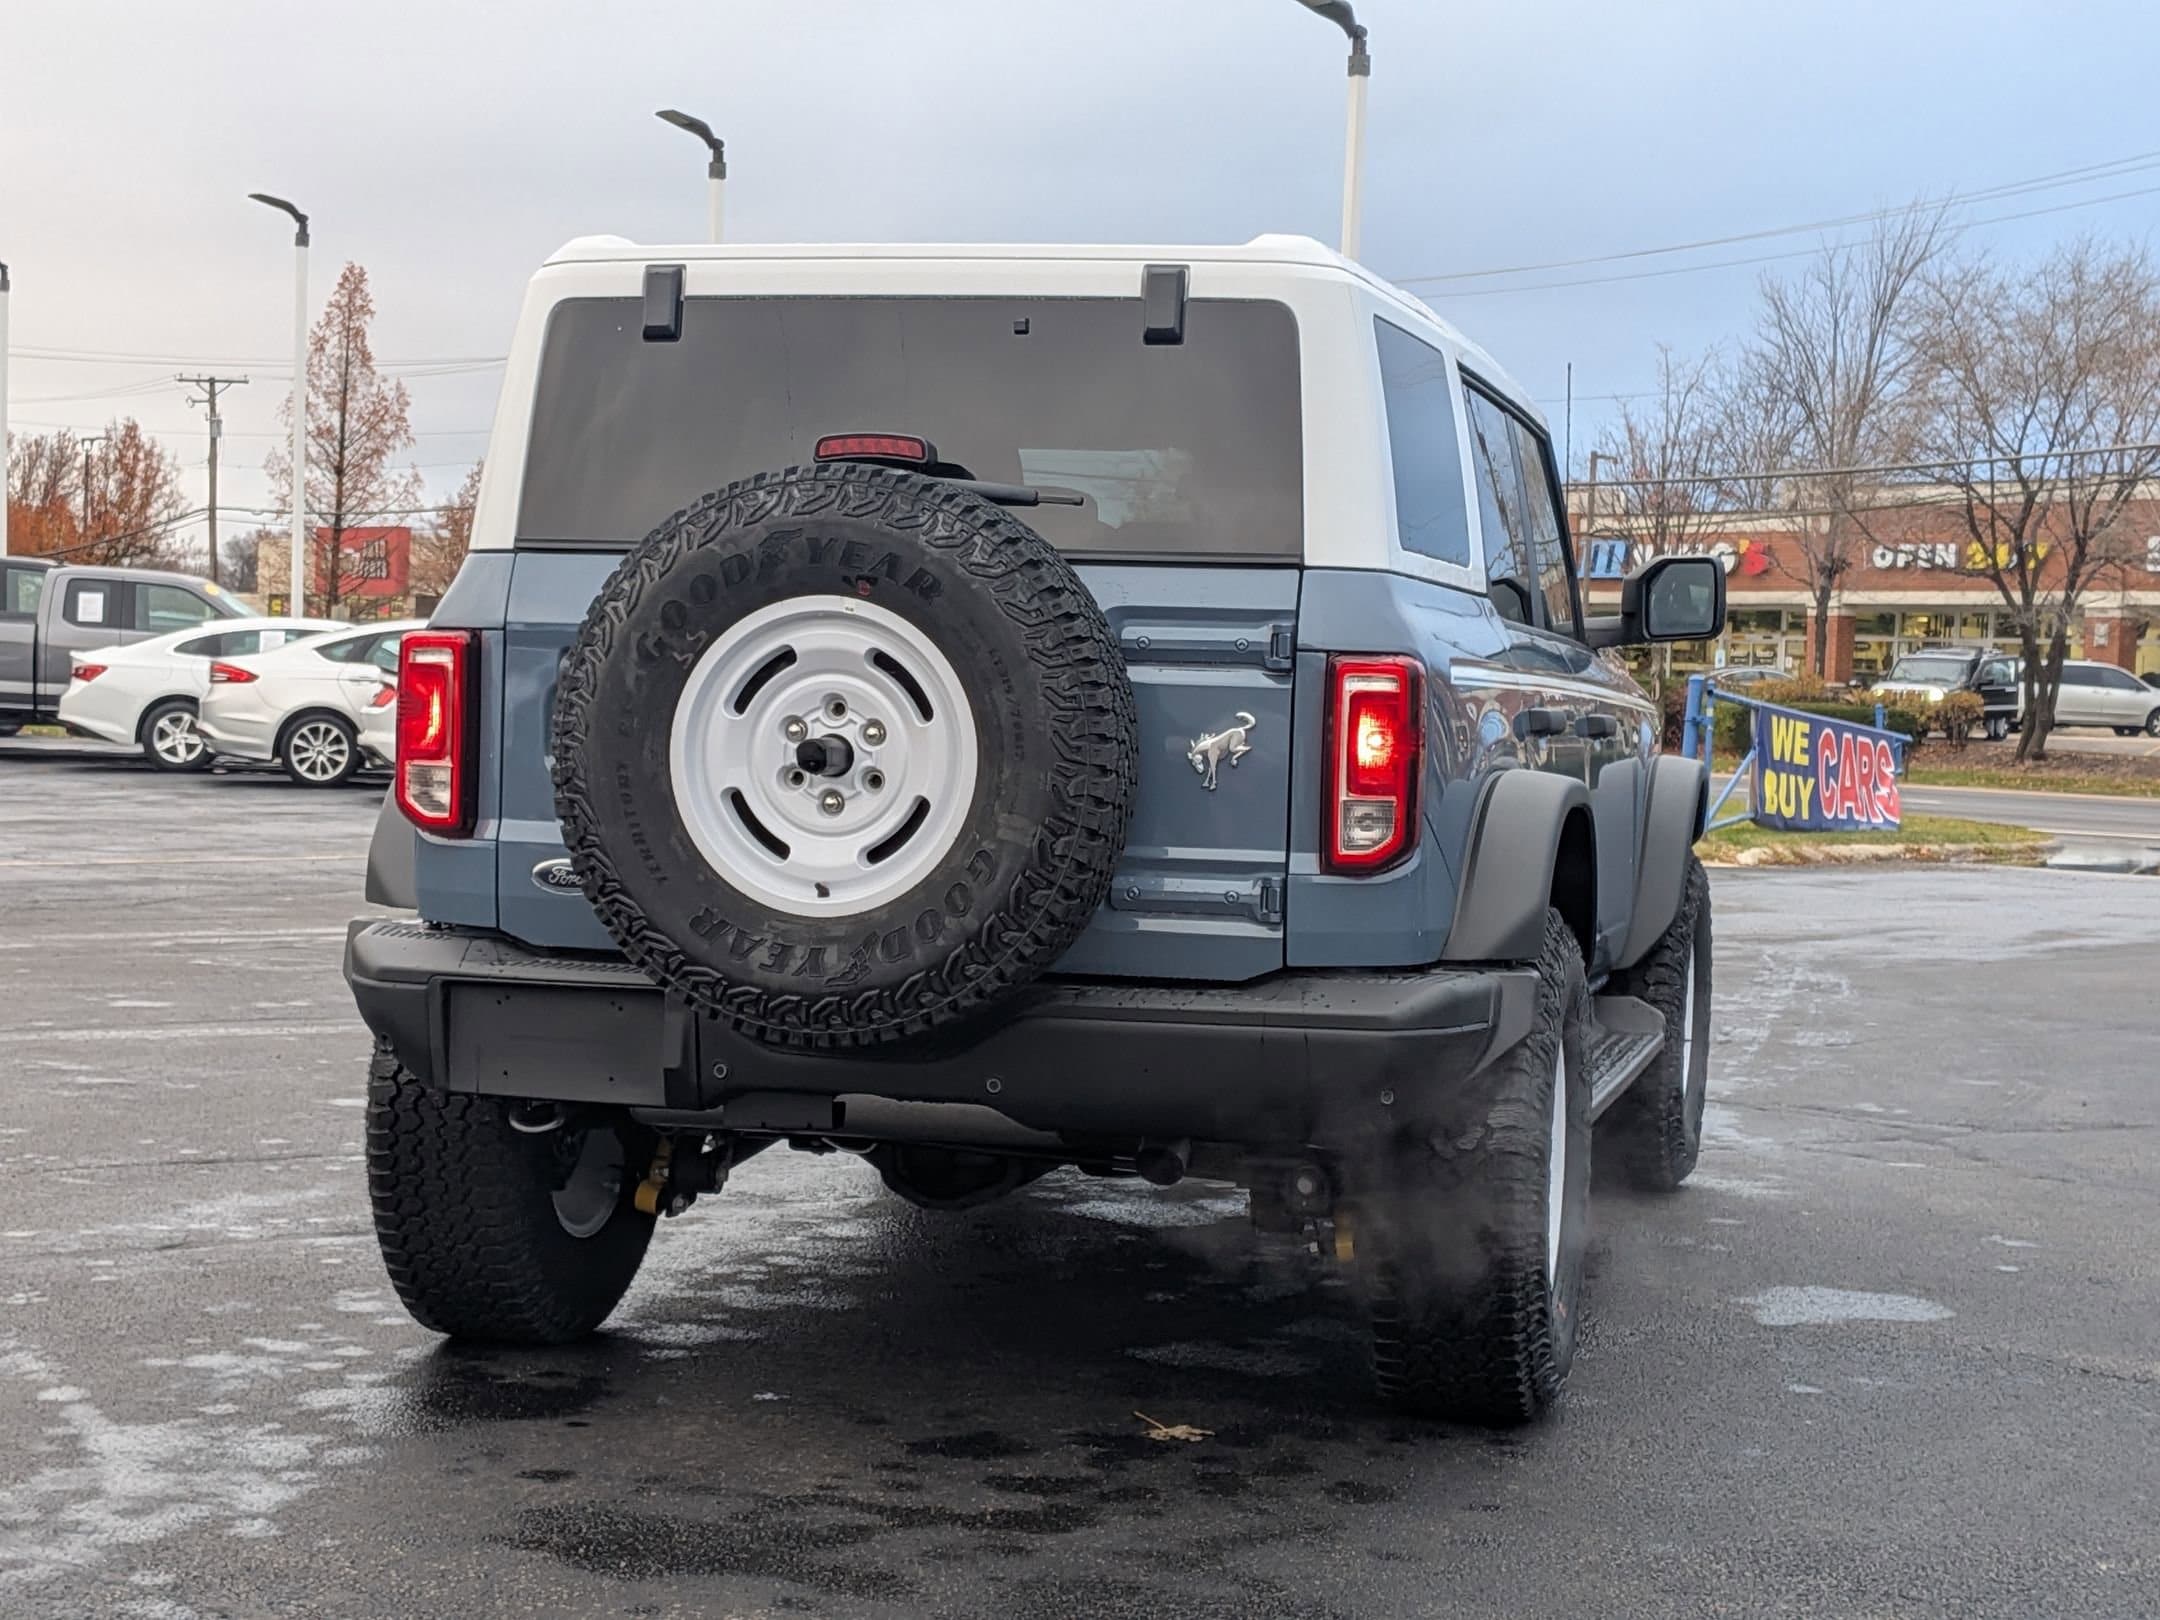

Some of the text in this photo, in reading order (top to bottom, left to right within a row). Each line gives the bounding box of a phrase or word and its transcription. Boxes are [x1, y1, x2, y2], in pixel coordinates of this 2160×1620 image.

[1872, 543, 1957, 569] OPEN
[635, 528, 944, 662] GOODYEAR
[1771, 714, 1810, 766] WE
[1818, 727, 1901, 824] CARS
[1764, 768, 1815, 820] BUY
[689, 848, 996, 988] GOODYEAR
